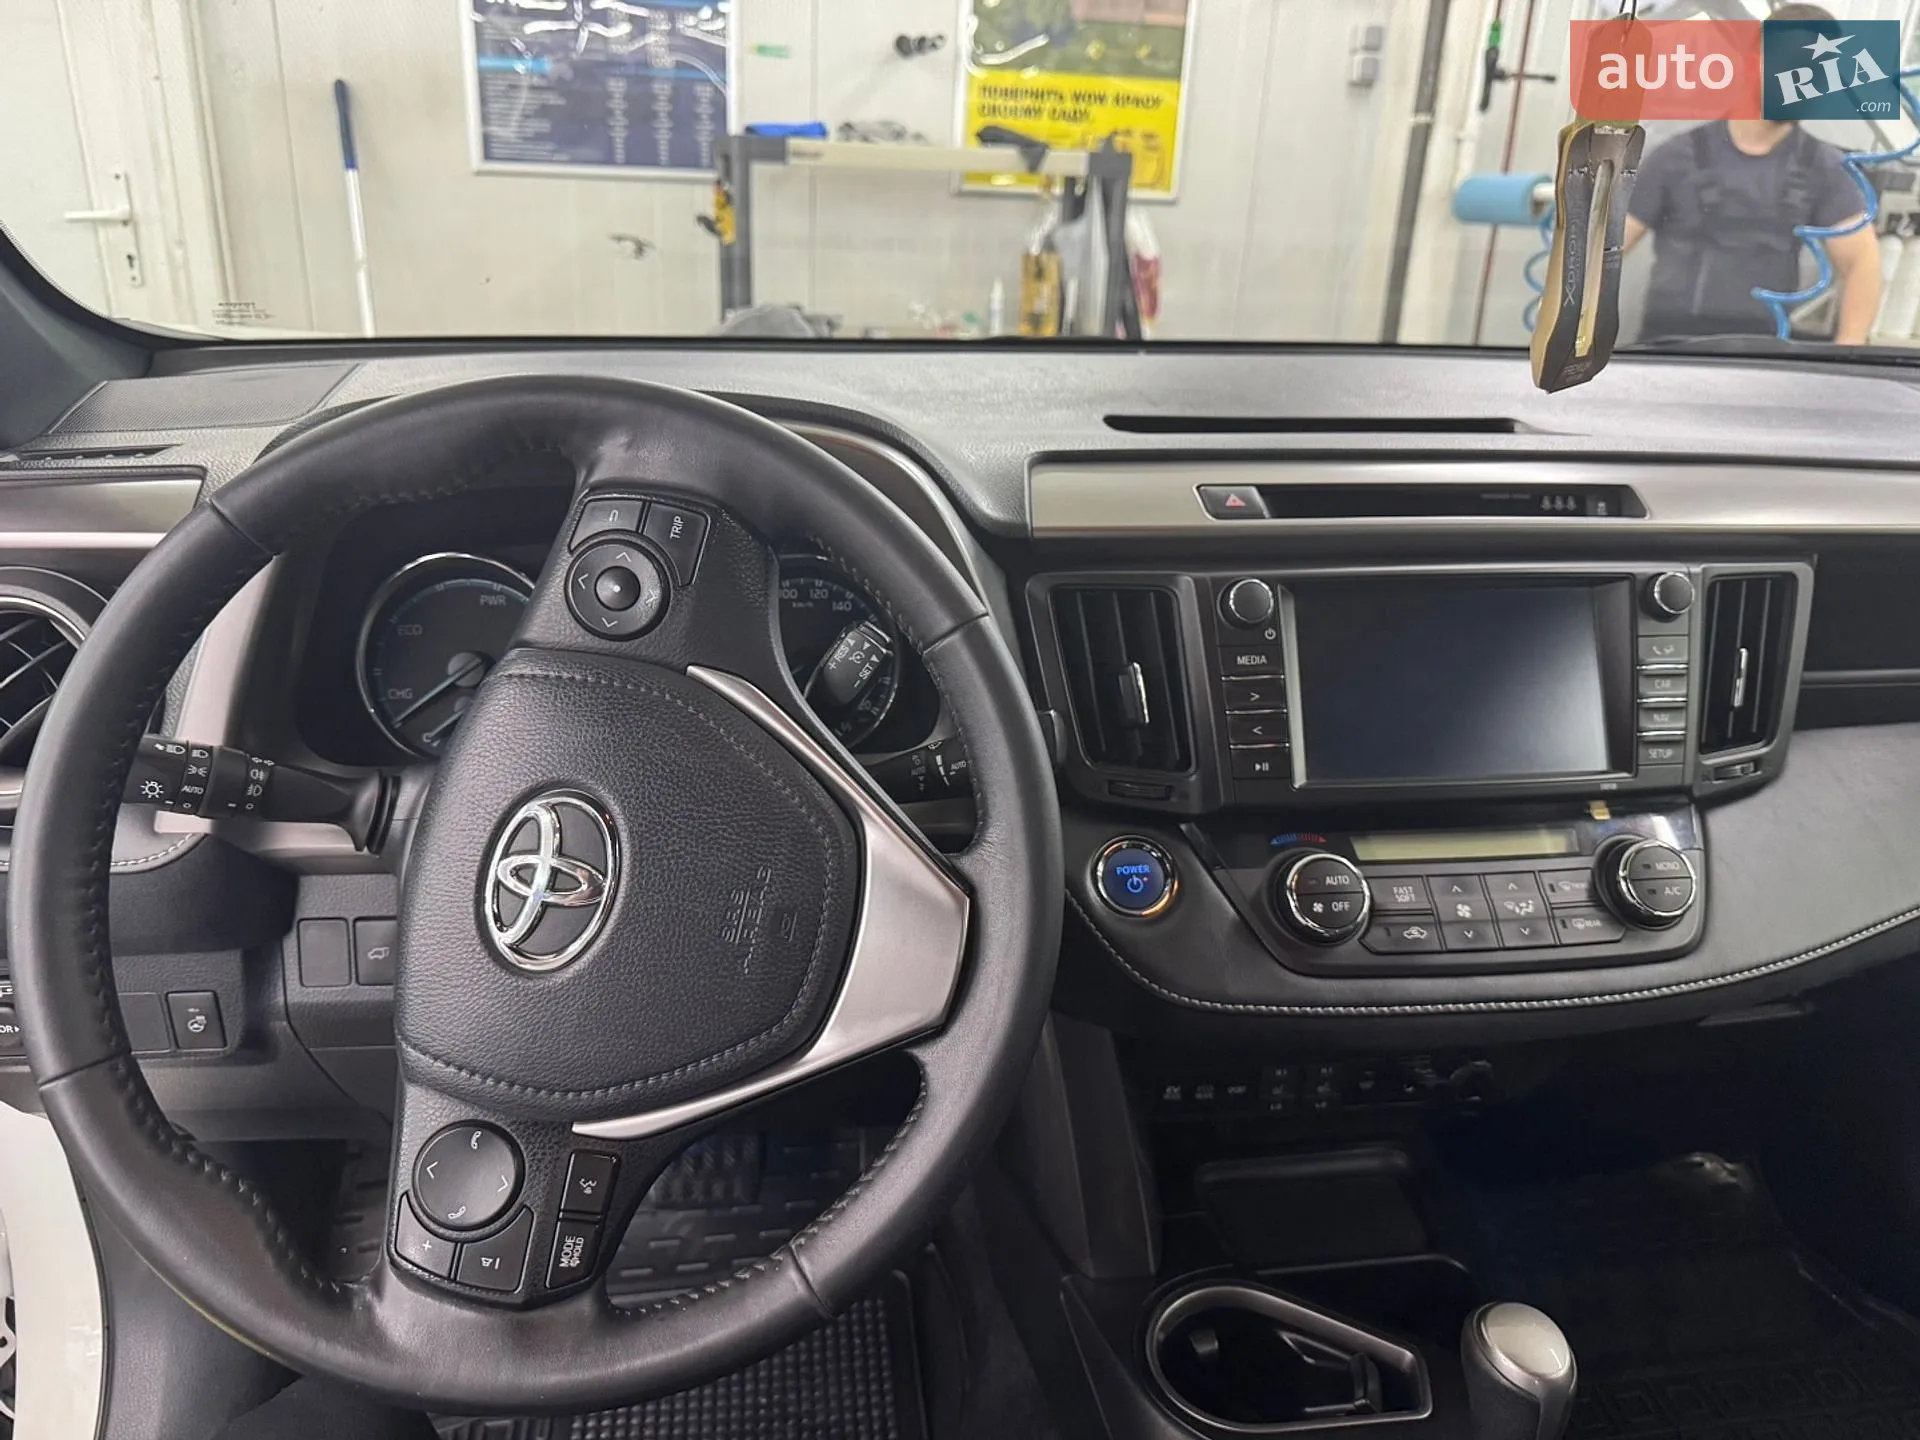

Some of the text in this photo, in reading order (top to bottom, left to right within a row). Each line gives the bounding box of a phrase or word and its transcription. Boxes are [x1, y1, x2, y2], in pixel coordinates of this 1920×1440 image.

[670, 515, 684, 540] TRIP
[479, 594, 506, 607] PWR
[397, 624, 423, 636] ECO
[1237, 655, 1268, 666] MEDIA
[1654, 679, 1672, 689] CAR
[388, 688, 413, 700] CHG
[1653, 713, 1670, 722] NAV
[1648, 748, 1673, 759] SETUP
[951, 761, 966, 771] AUTO
[181, 785, 204, 795] AUTO
[1115, 864, 1151, 876] POWER
[1325, 875, 1350, 886] AUTO
[1393, 886, 1414, 894] FAST
[1663, 885, 1681, 896] A/C
[1395, 893, 1416, 903] SOFT
[1331, 901, 1351, 912] OFF
[559, 1235, 576, 1267] MODE
[572, 1237, 584, 1260] HOLD
